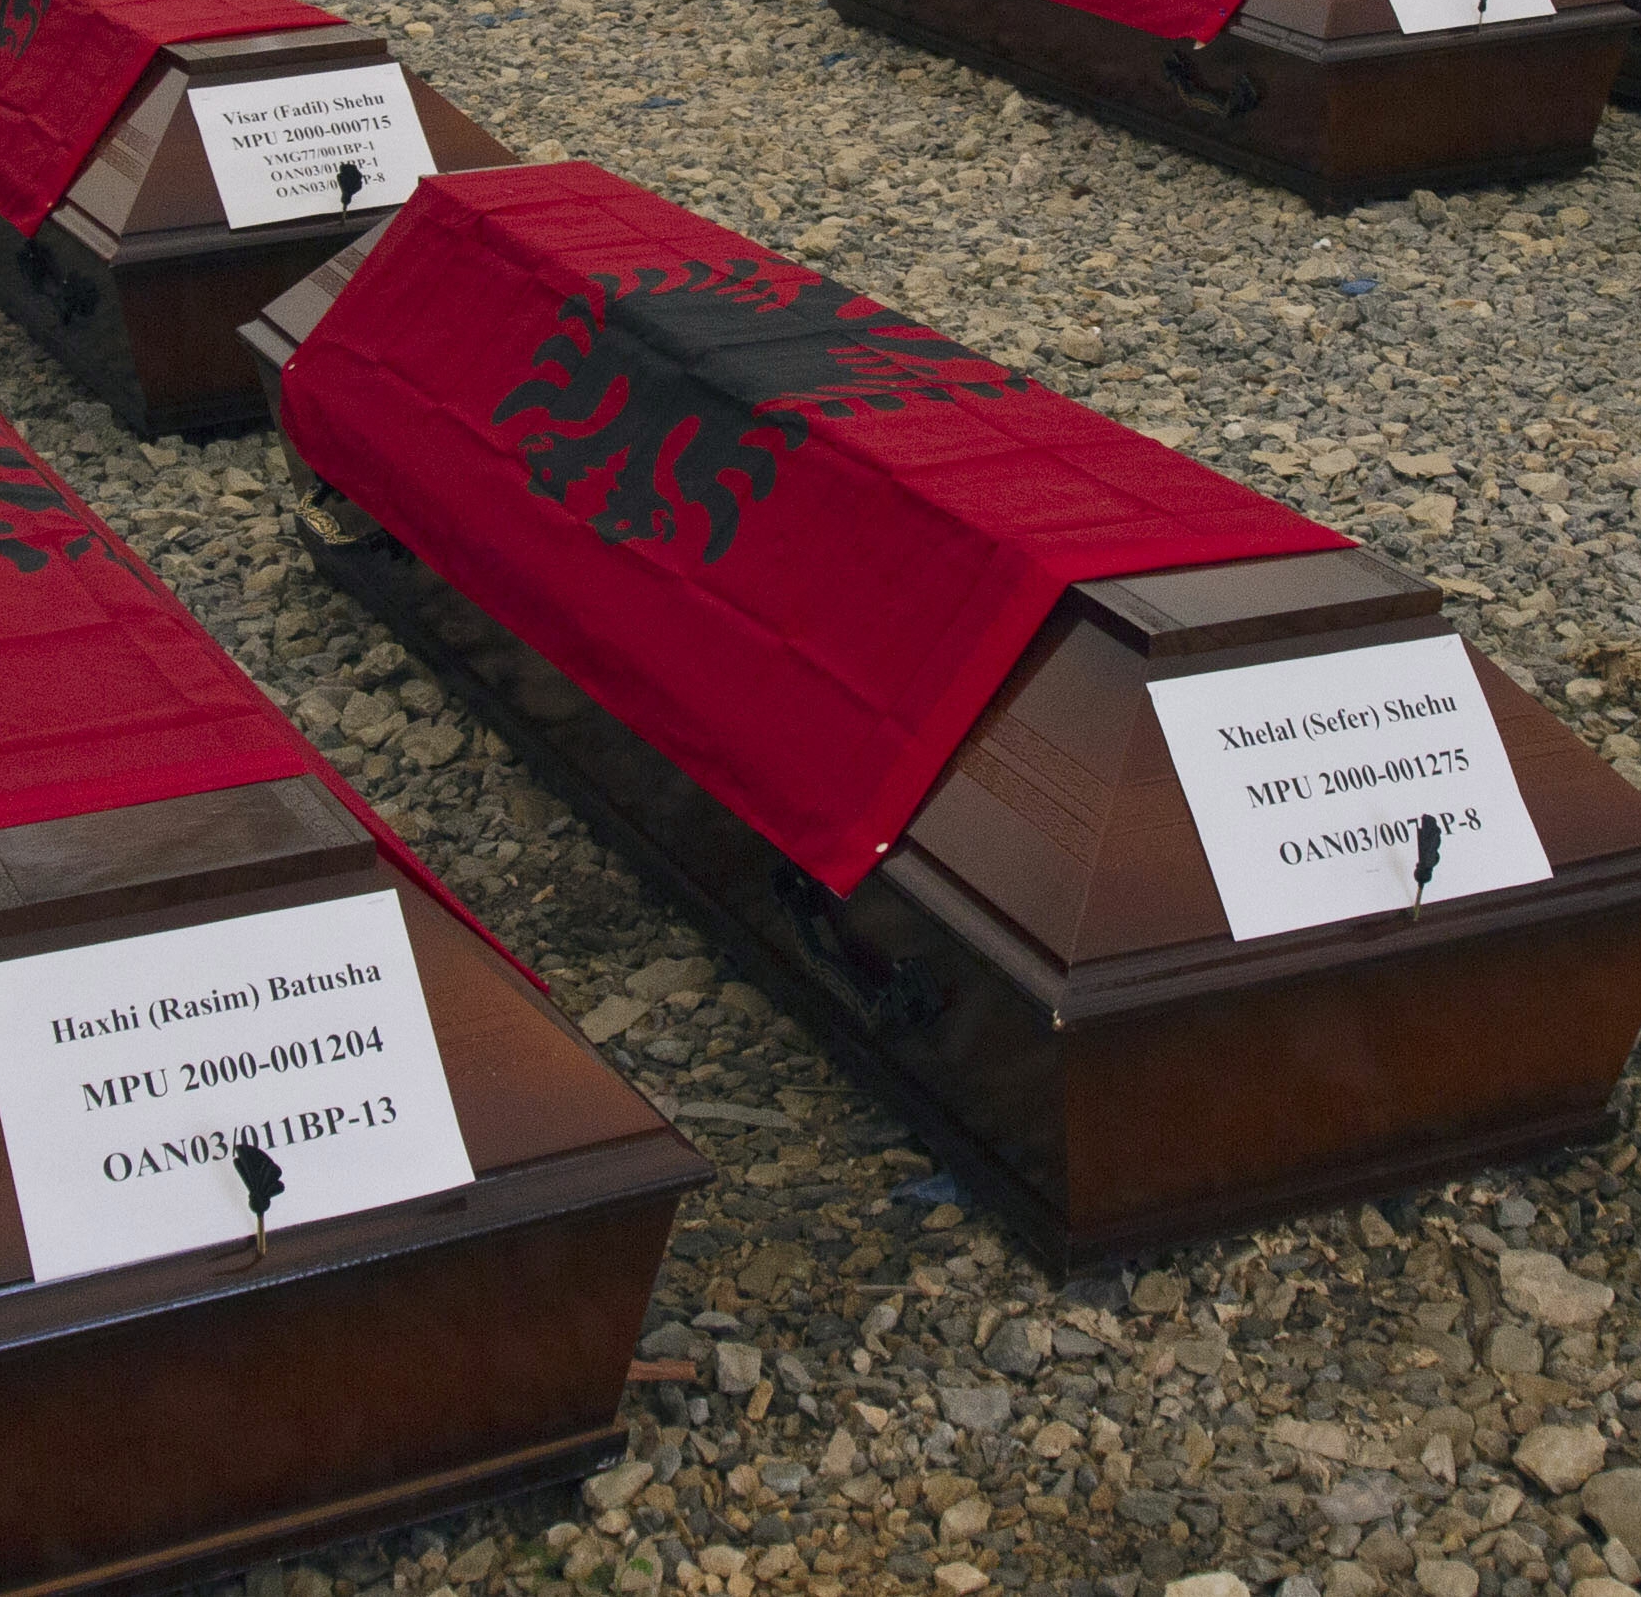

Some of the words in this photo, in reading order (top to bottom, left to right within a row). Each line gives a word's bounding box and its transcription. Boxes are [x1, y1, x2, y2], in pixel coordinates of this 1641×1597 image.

[222, 109, 269, 127] Visar
[272, 101, 330, 123] (Fadil)
[332, 93, 386, 113] Shehu
[232, 130, 279, 151] MPU
[285, 114, 393, 145] 2000-000715
[263, 140, 375, 167] YMG77/001BP-1
[1216, 715, 1297, 752] Xhelal
[1302, 704, 1382, 743] (Sefer)
[1386, 692, 1459, 724] Shehu
[1245, 775, 1313, 810] MPU
[1318, 747, 1471, 797] 2000-001275
[50, 1004, 141, 1046] Haxhi
[147, 982, 262, 1033] (Rasim)
[266, 961, 383, 1004] Batusha
[81, 1068, 170, 1113] MPU
[179, 1025, 385, 1093] 2000-001204
[102, 1095, 398, 1184] OAN03/011BP-13
